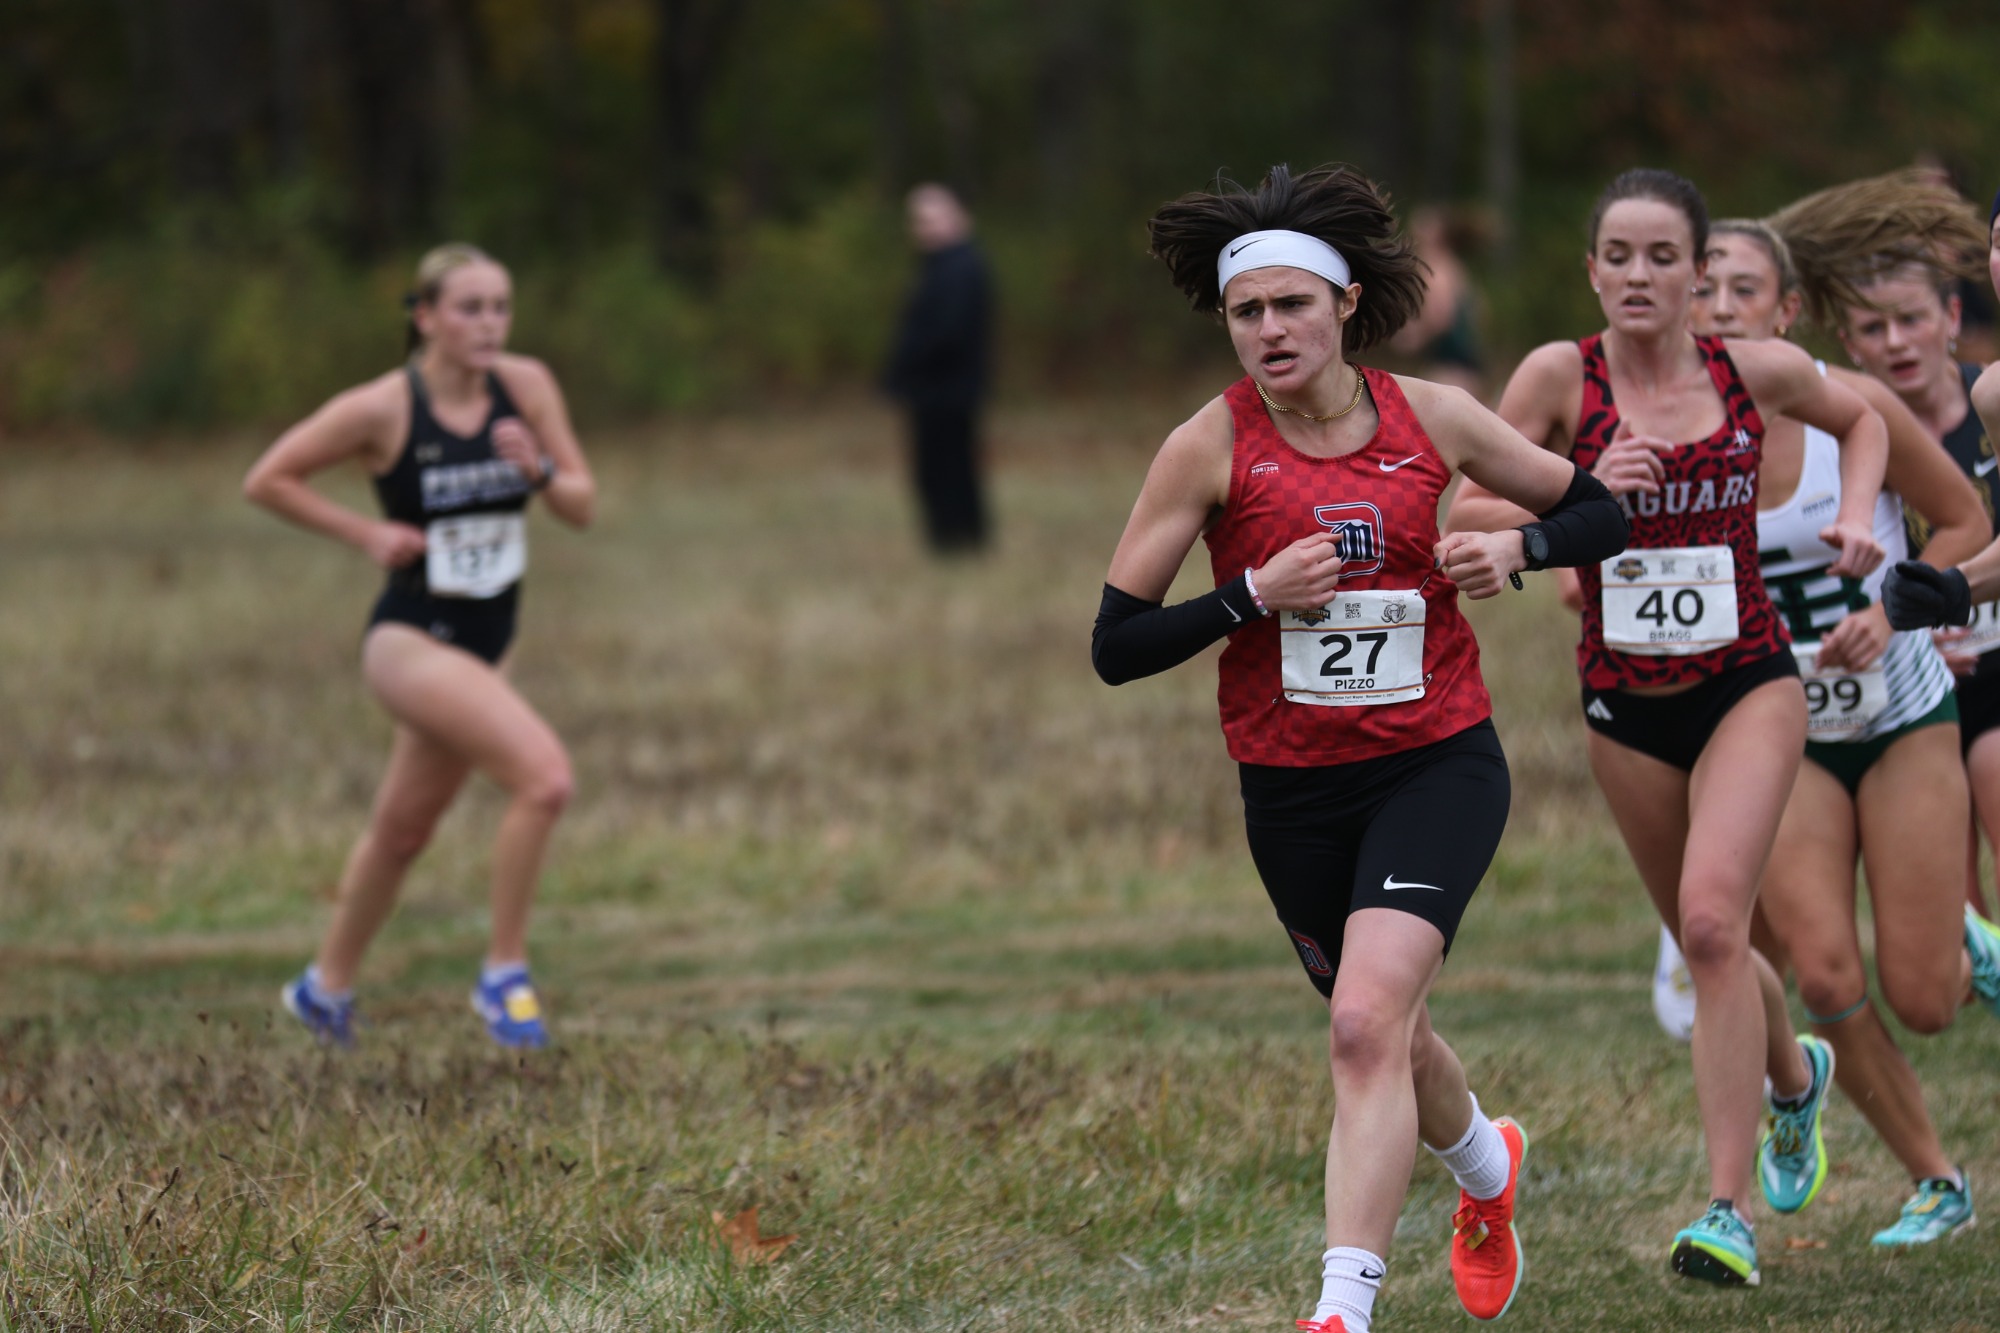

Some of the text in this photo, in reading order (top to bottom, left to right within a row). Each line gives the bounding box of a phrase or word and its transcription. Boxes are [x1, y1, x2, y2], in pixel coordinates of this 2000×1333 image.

[1251, 466, 1279, 474] HORIZON
[1617, 472, 1755, 520] AGUARS
[1635, 589, 1704, 627] 40
[1319, 632, 1388, 676] 27
[1334, 678, 1375, 690] PIZZO
